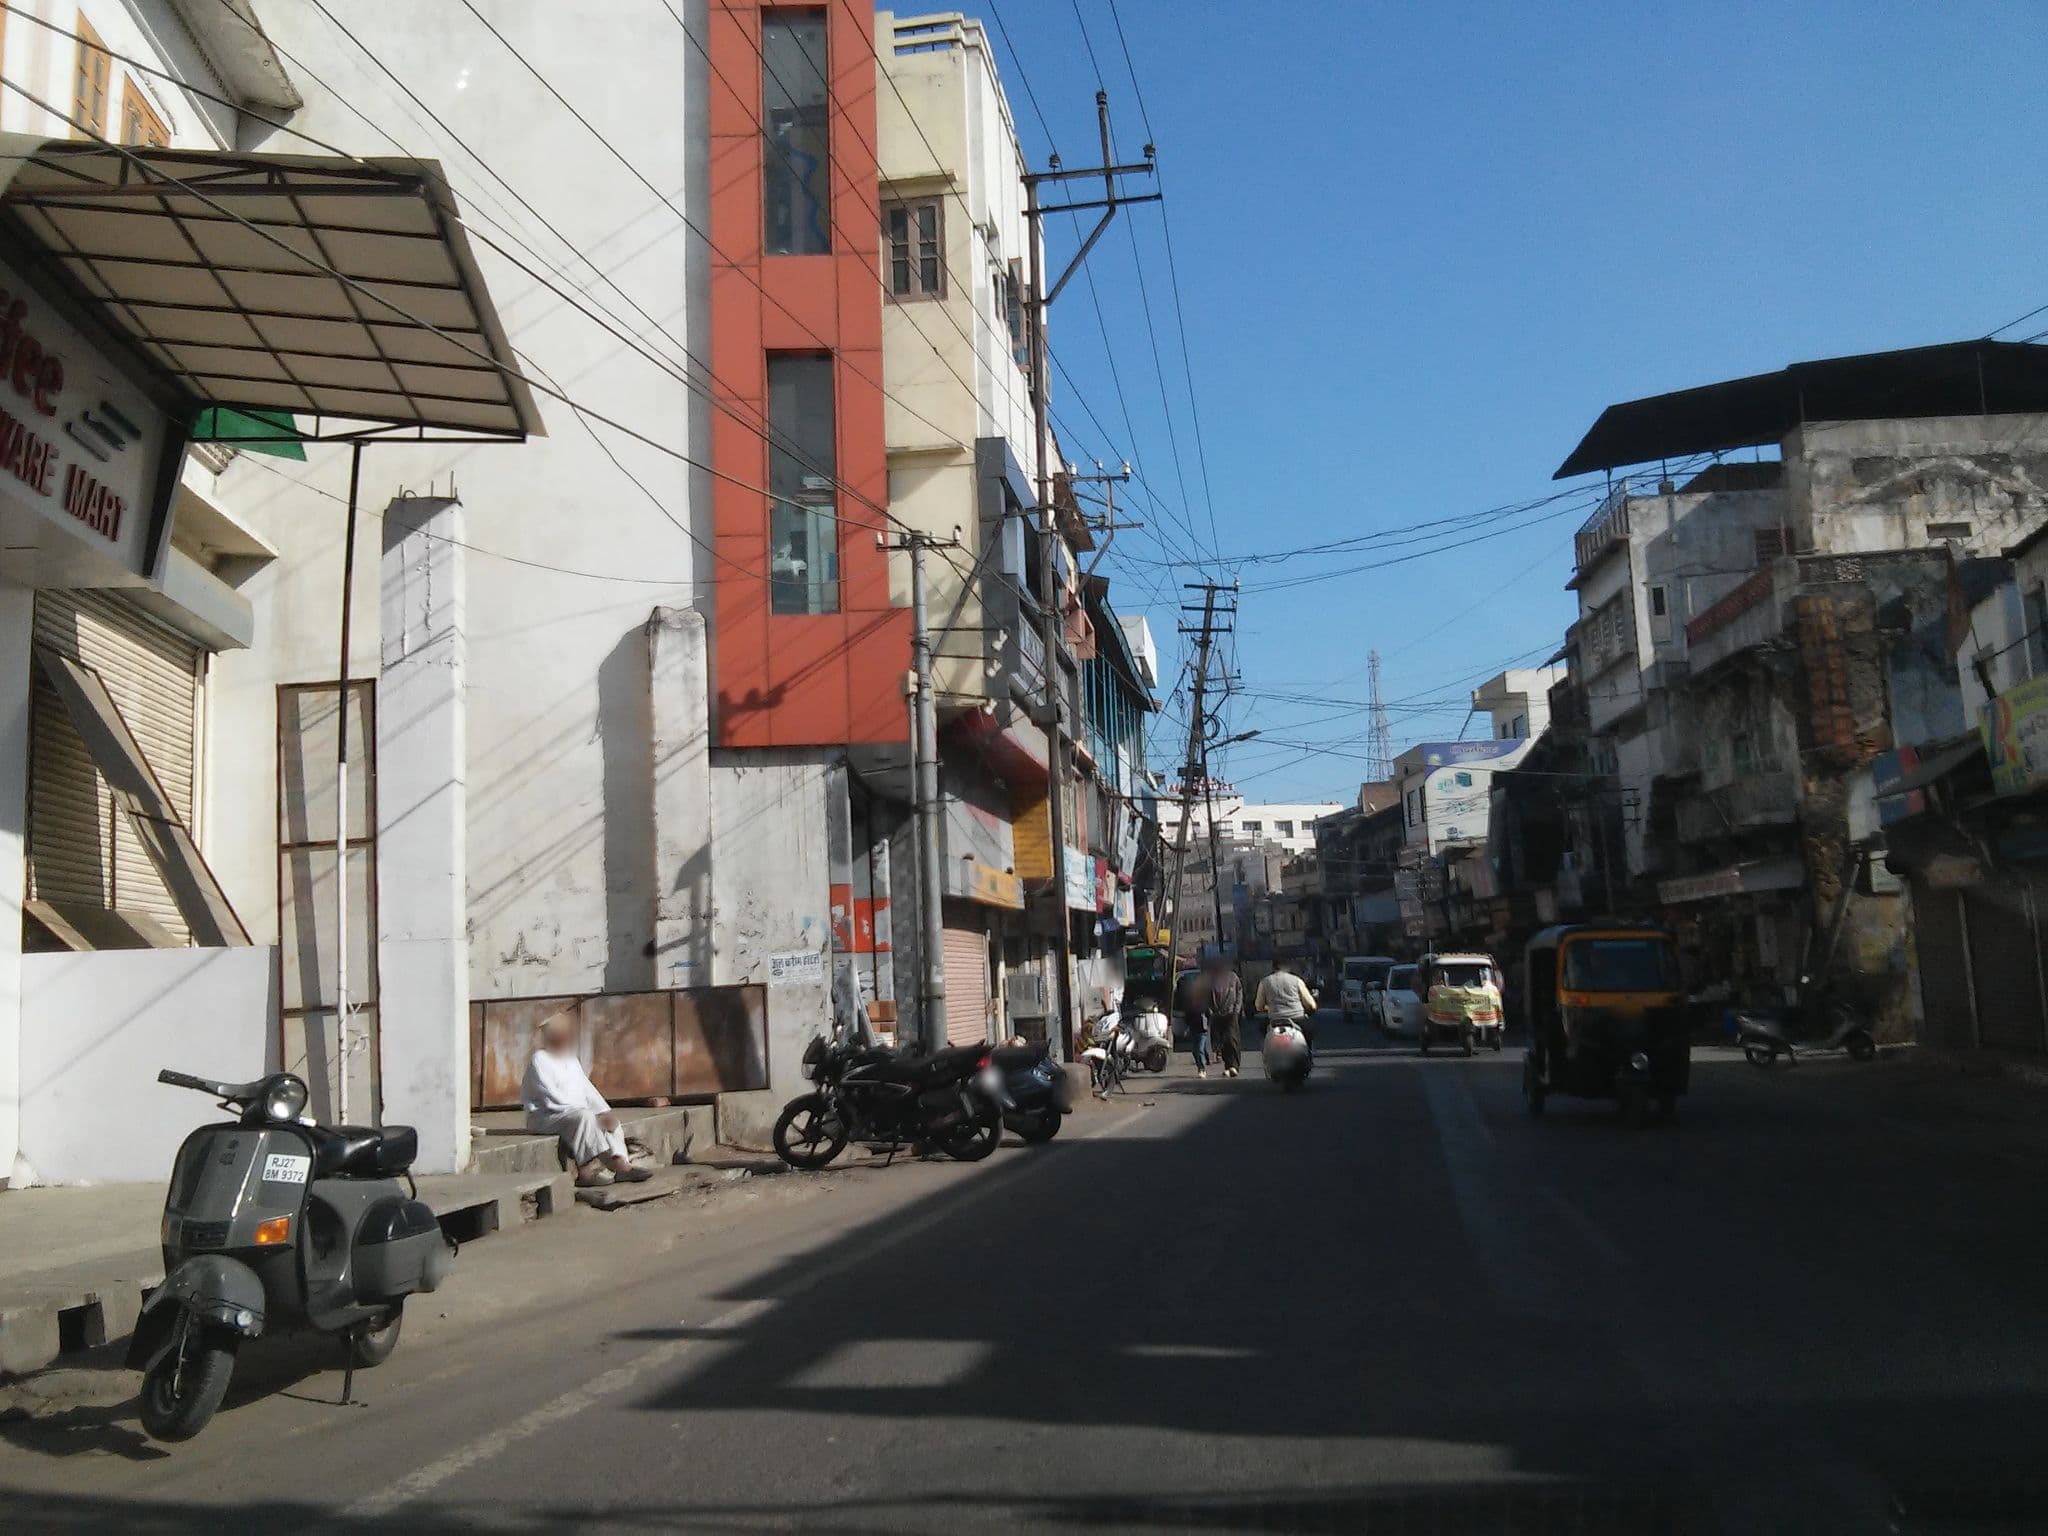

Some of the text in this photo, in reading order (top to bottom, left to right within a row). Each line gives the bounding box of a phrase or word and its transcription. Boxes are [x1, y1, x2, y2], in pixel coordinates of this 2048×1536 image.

[65, 463, 127, 541] MART
[271, 1157, 296, 1168] RJ27
[281, 1170, 304, 1182] 9372
